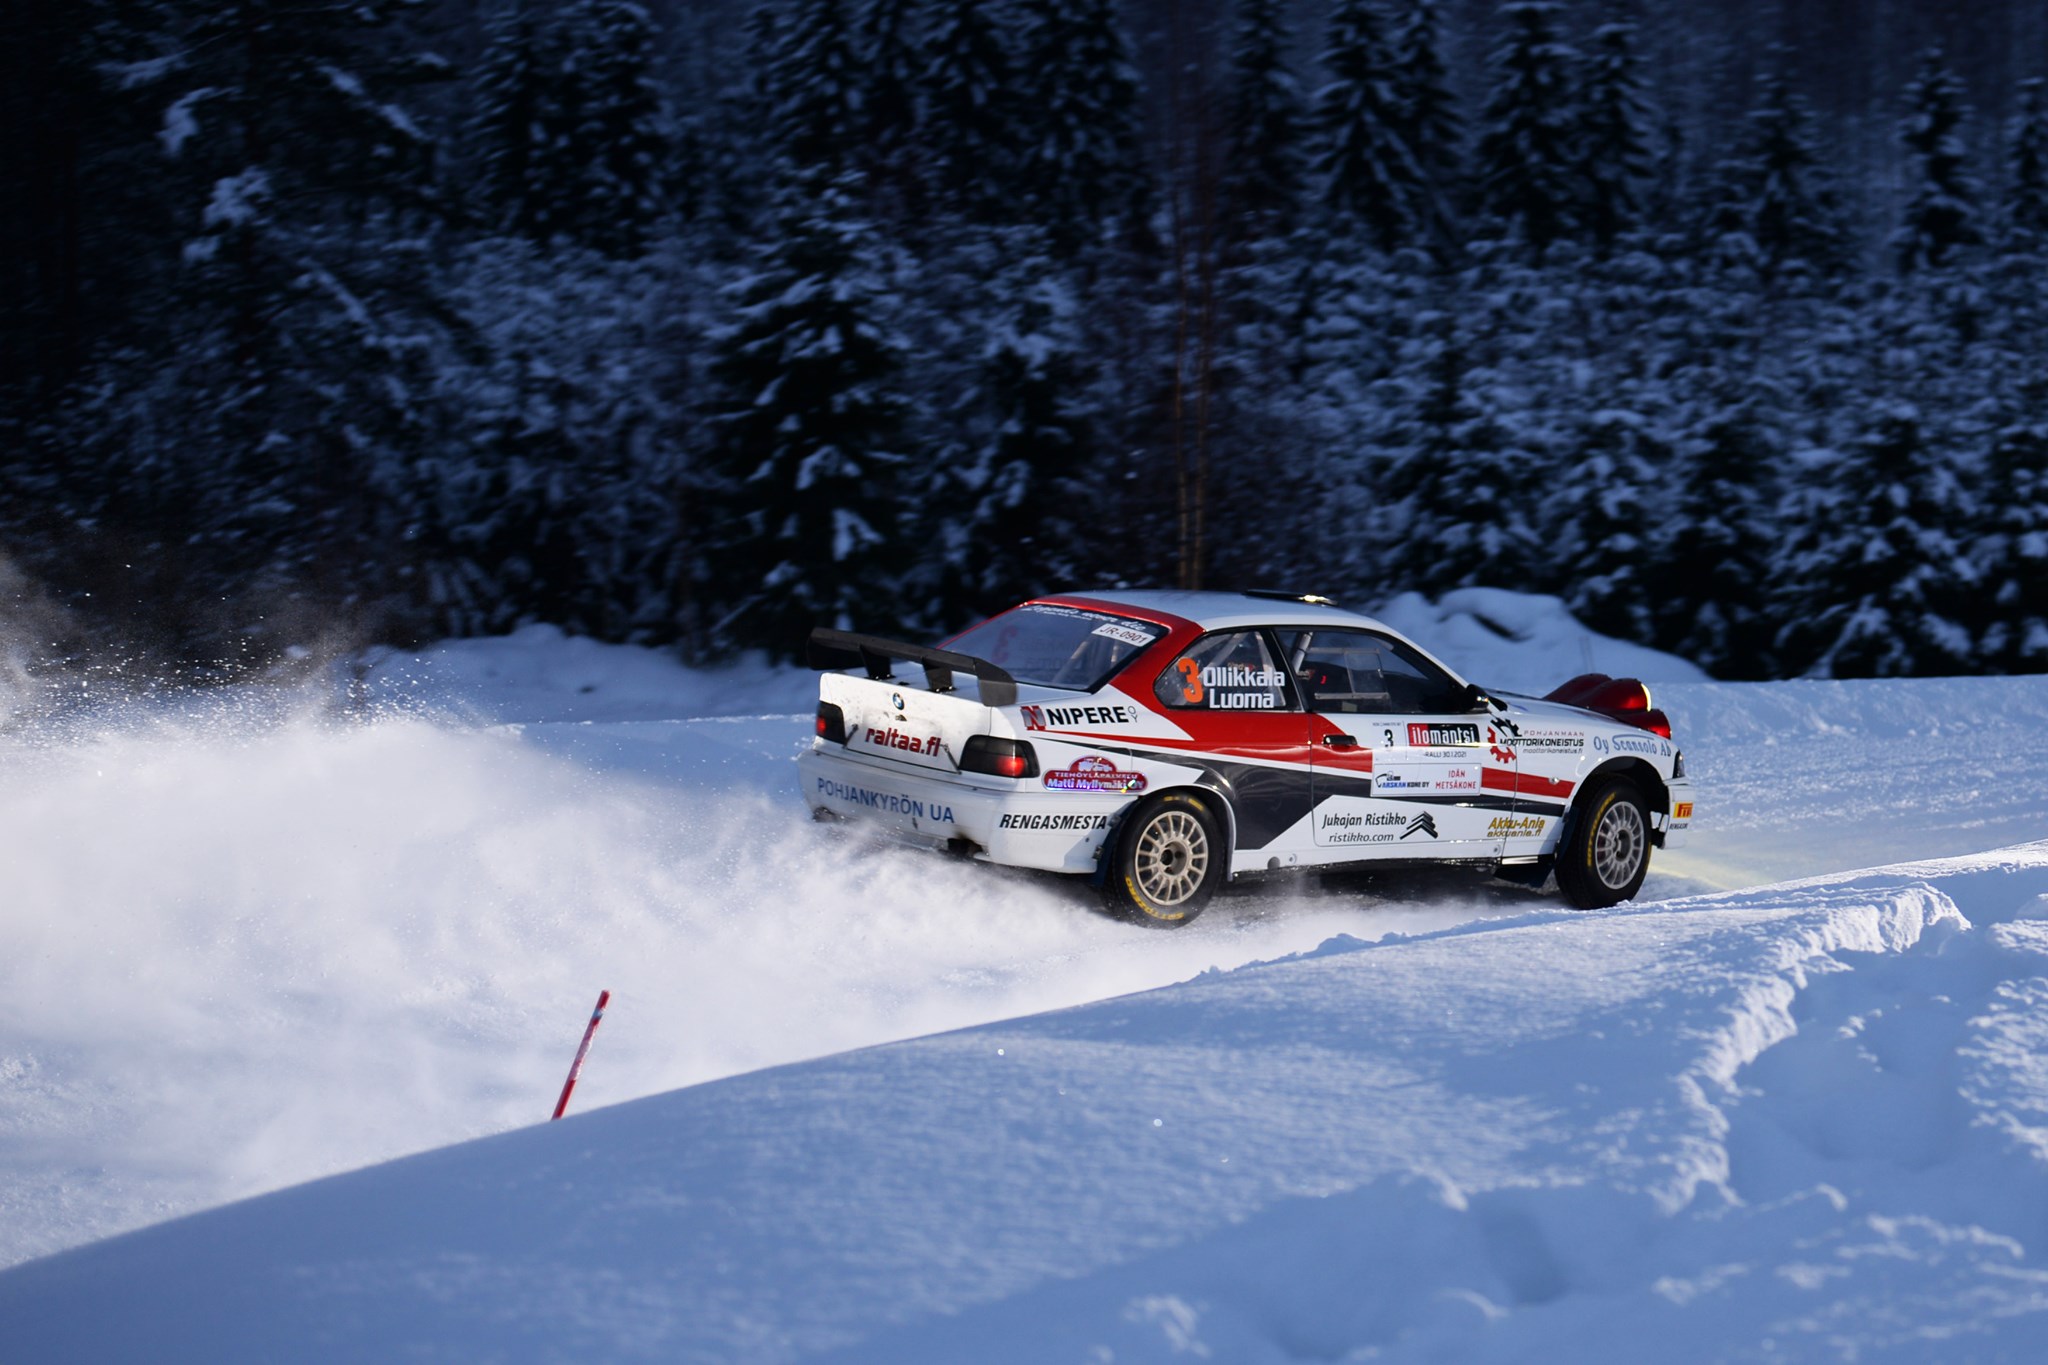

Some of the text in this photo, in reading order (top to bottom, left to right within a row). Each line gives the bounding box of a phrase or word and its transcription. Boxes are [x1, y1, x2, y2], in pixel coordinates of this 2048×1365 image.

[1100, 626, 1148, 643] JR-0901
[1178, 657, 1203, 703] 3
[1203, 667, 1285, 686] Ollikkala
[1209, 689, 1274, 708] Luoma
[1046, 706, 1129, 725] NIPERE
[1384, 729, 1394, 752] 3
[1412, 727, 1475, 744] ilomantsi
[1500, 738, 1584, 747] MOOTTORIKONEISTUS
[1594, 736, 1609, 754] Oy
[1047, 779, 1075, 788] Matti
[818, 778, 955, 823] POHJANKYRÖN UA
[1000, 814, 1107, 830] RENGASMESTA
[1322, 812, 1406, 829] Jukajan Ristikko
[1329, 832, 1394, 842] ristikko.com
